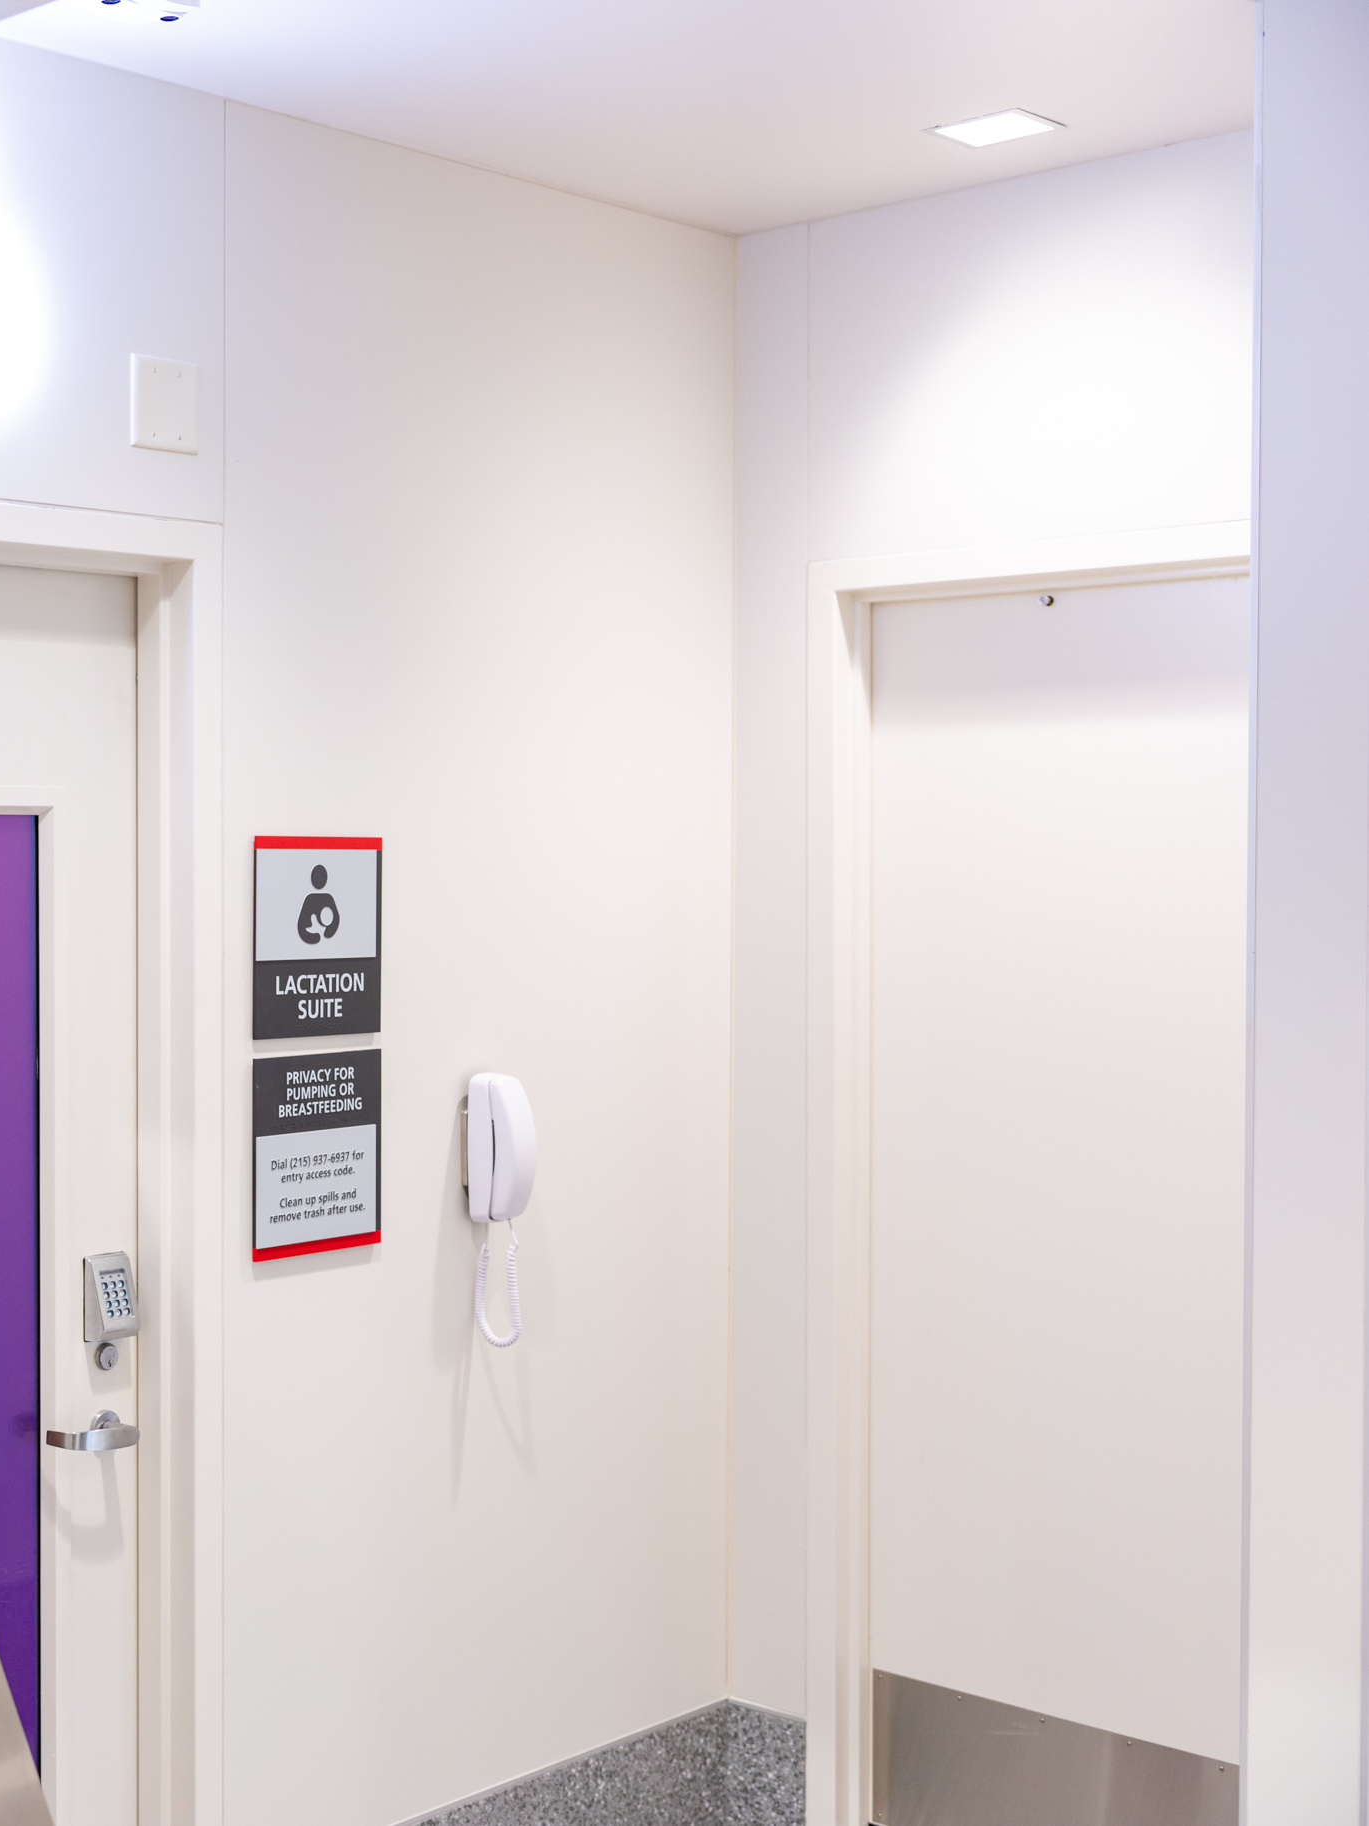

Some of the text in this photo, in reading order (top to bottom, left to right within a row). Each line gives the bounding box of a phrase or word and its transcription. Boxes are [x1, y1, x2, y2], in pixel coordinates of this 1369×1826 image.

[276, 972, 364, 995] LACTATION
[298, 998, 343, 1019] SUITE
[286, 1067, 354, 1085] PRIVACY FOR
[287, 1083, 354, 1101] PUMPING OR
[278, 1097, 362, 1118] BREASTFEEDING
[271, 1149, 364, 1171] Dial (215) 937-6937 for
[281, 1165, 355, 1184] entry access code.
[280, 1188, 356, 1209] Clean up spills and
[270, 1202, 365, 1224] remove trash after use.
